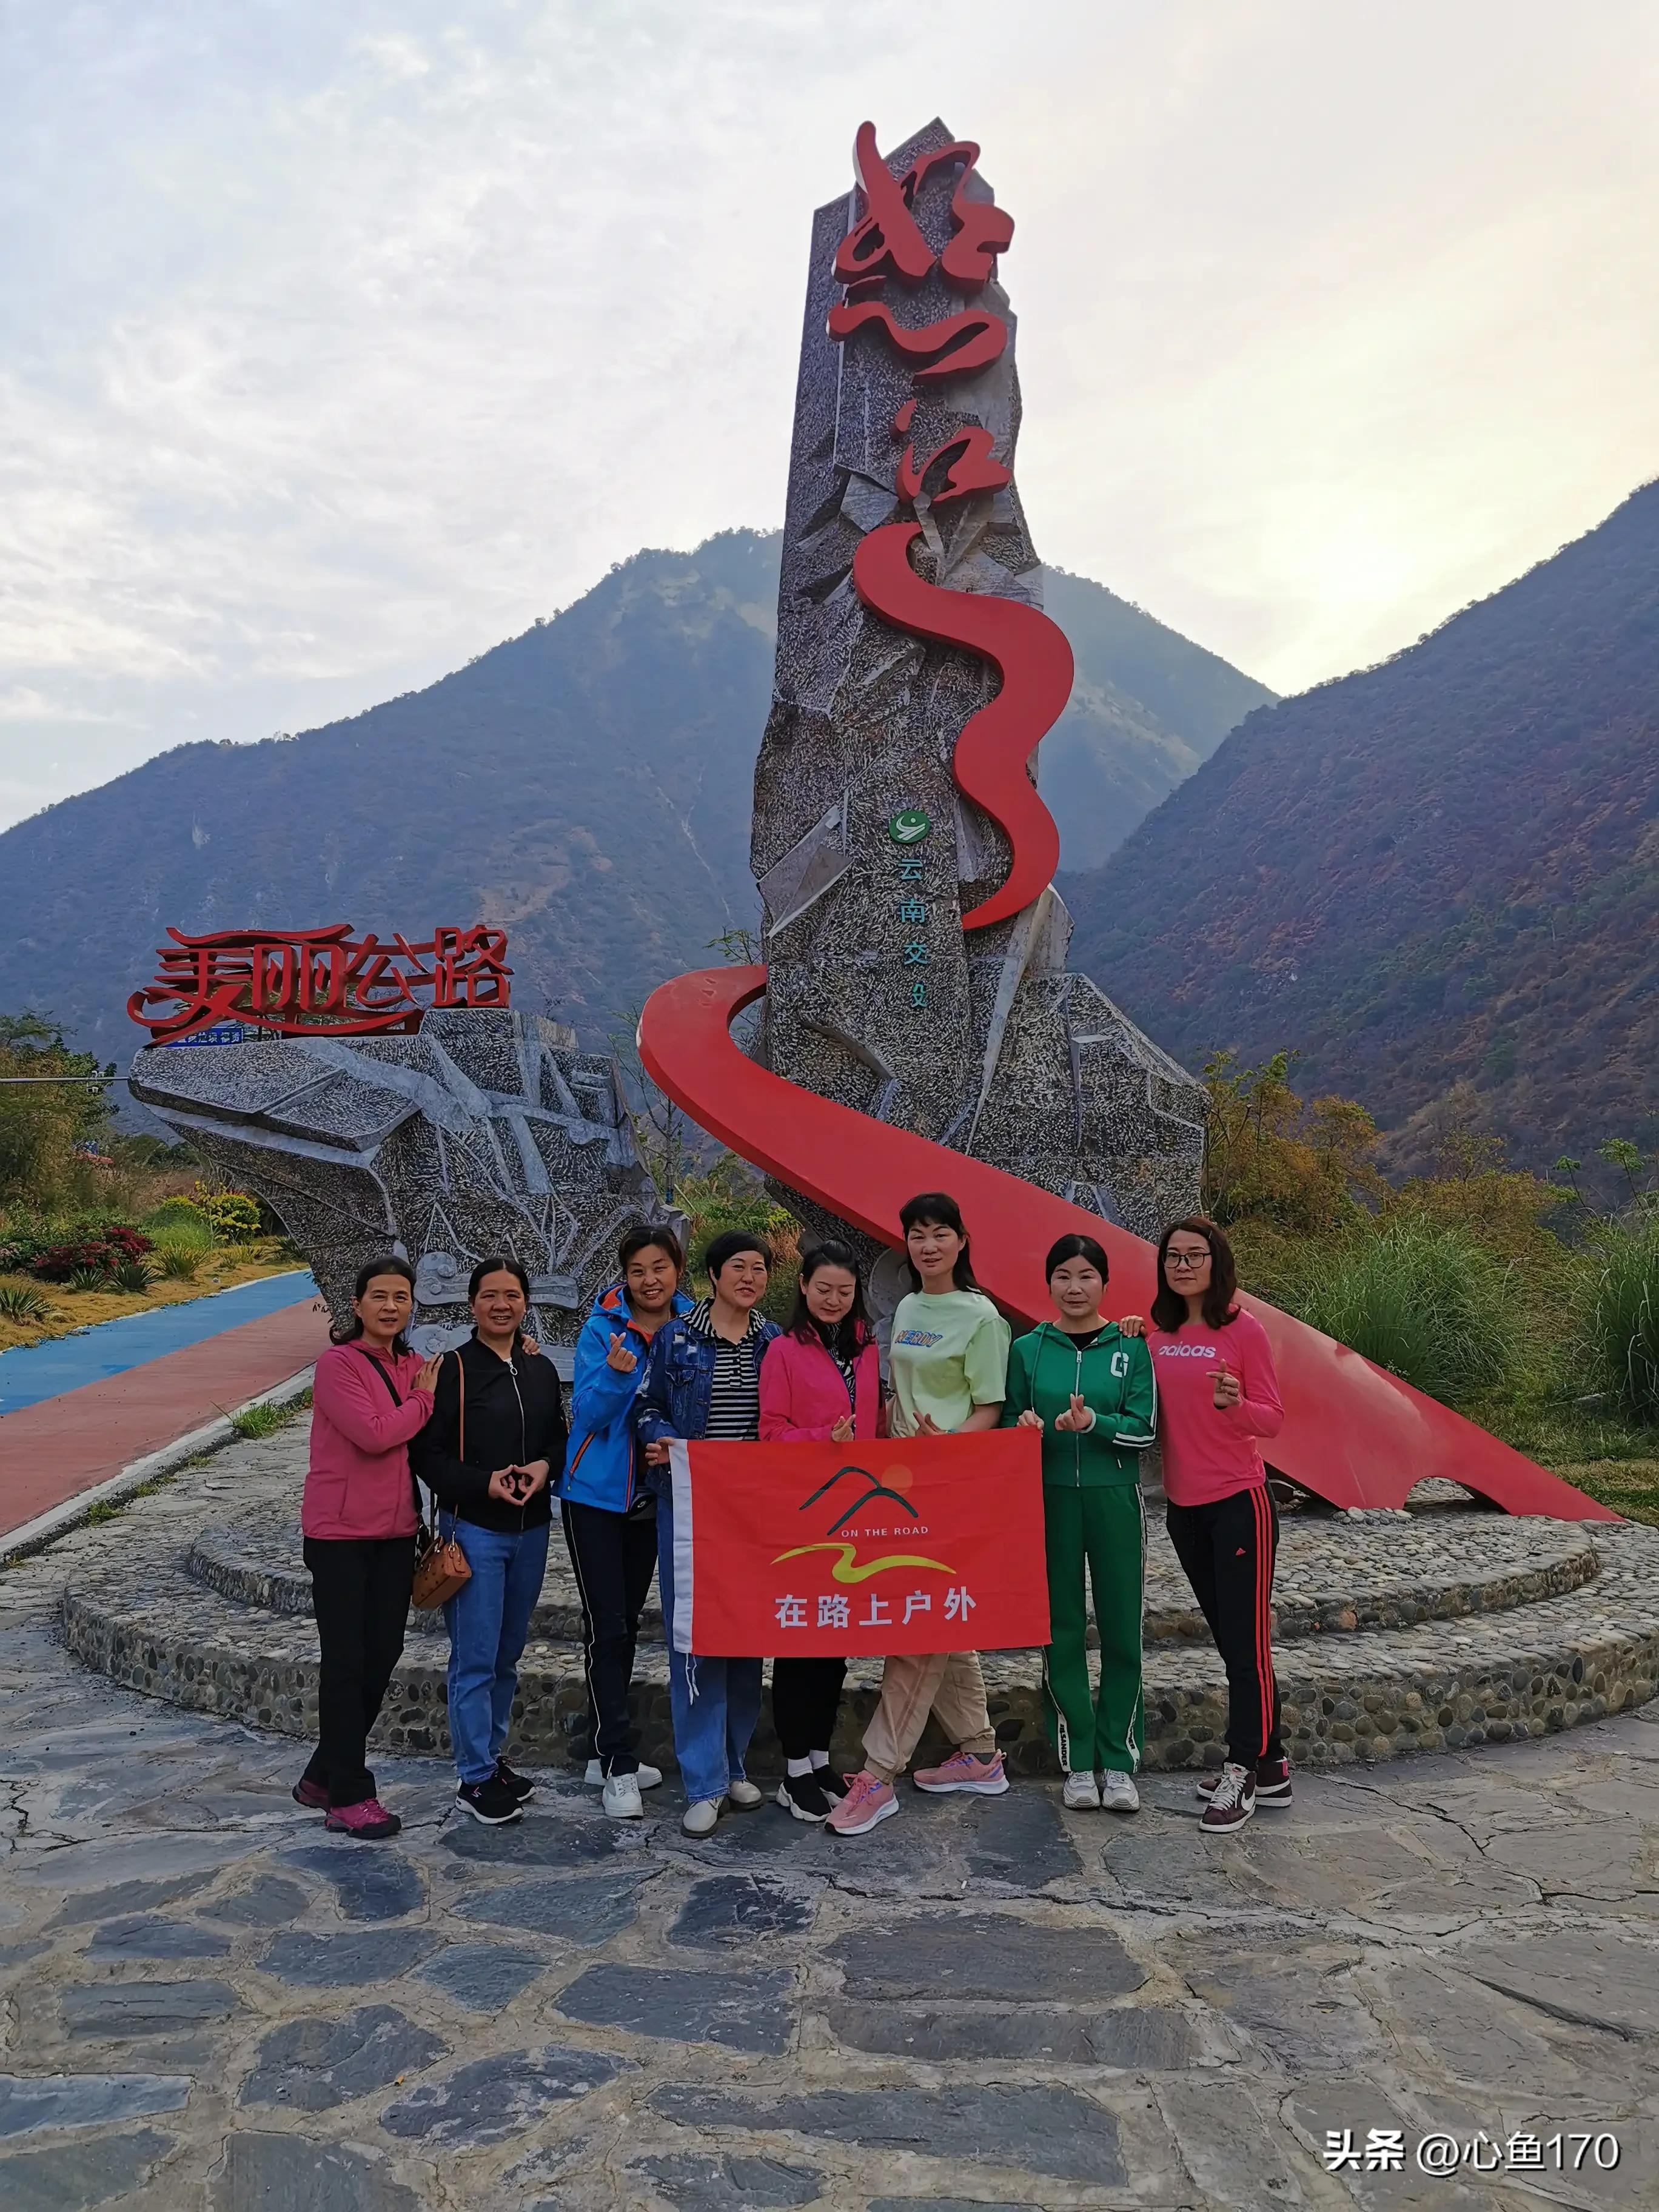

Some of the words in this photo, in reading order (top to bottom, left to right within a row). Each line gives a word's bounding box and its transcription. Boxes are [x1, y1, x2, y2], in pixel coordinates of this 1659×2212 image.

[127, 923, 514, 1048] 美丽公路
[842, 1529, 858, 1538] ON
[865, 1528, 888, 1537] THE
[894, 1526, 928, 1535] ROAD
[775, 1586, 977, 1629] 在路上户外
